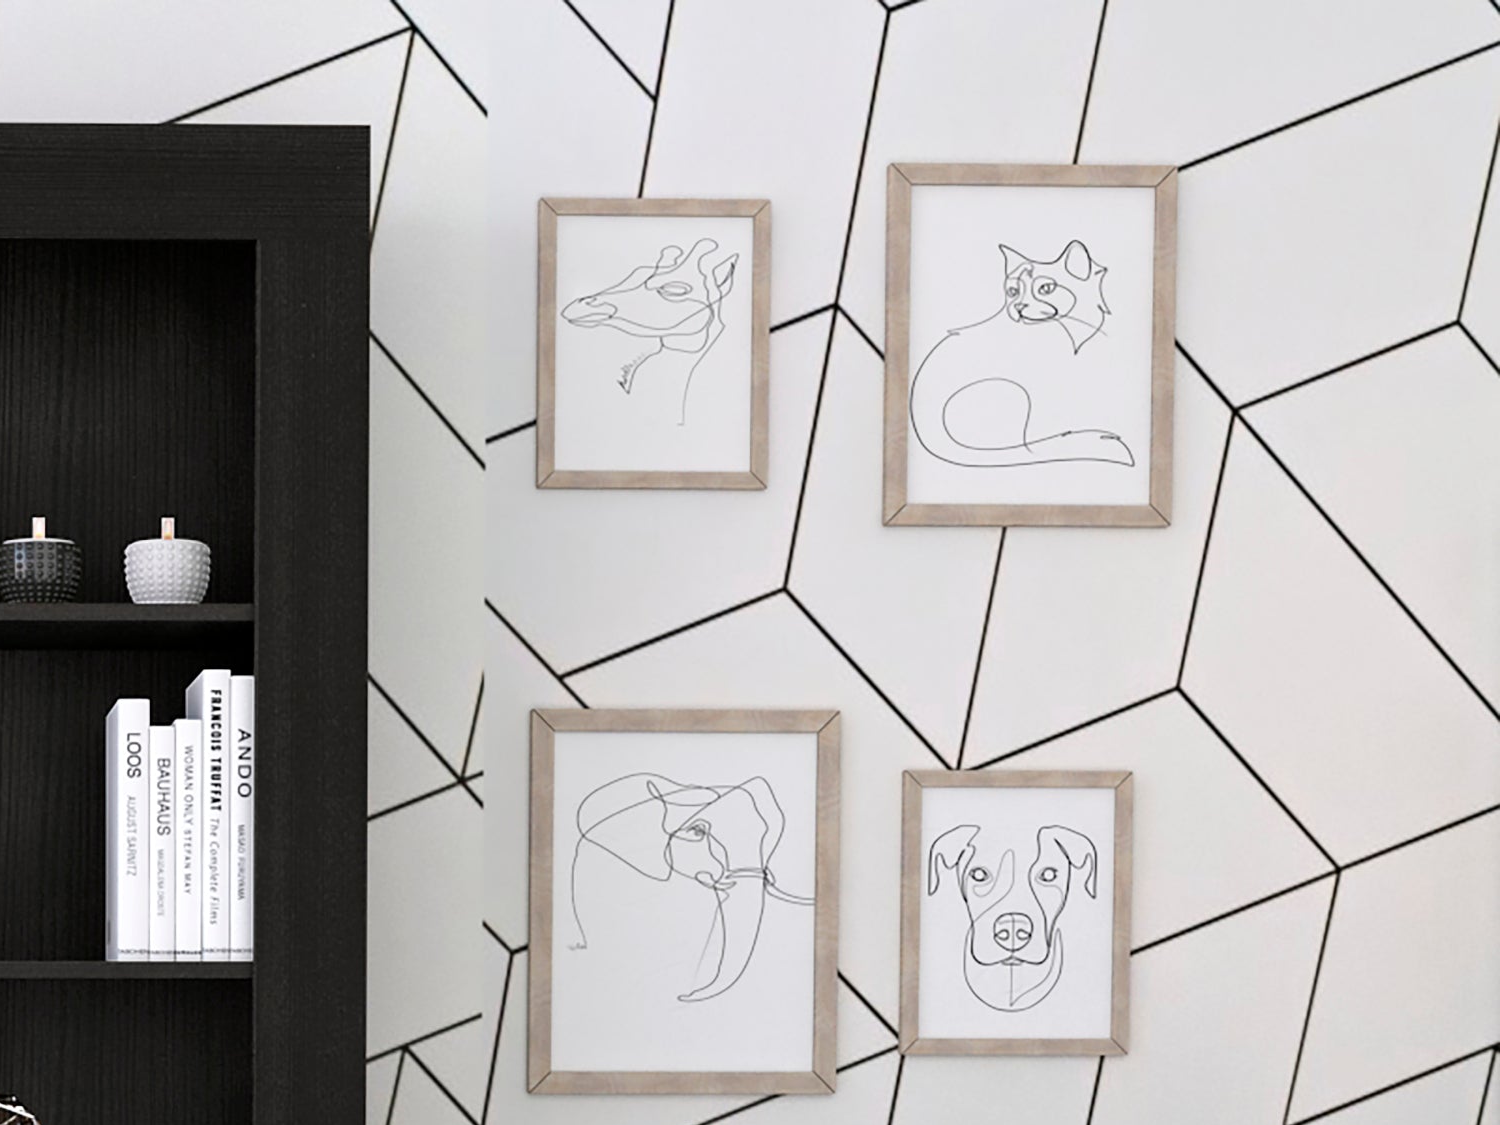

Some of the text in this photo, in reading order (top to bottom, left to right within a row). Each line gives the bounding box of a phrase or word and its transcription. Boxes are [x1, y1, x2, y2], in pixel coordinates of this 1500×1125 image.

[127, 732, 142, 778] LOOS
[184, 745, 194, 826] WOMAN ONLY
[210, 689, 222, 812] FRANCOIS TRUFFAT
[237, 728, 252, 798] ANDO
[126, 795, 138, 834] AUGUST
[157, 758, 171, 836] BAUHAUS
[183, 829, 192, 895] STEFAN MAY
[208, 818, 220, 925] The Complete Films
